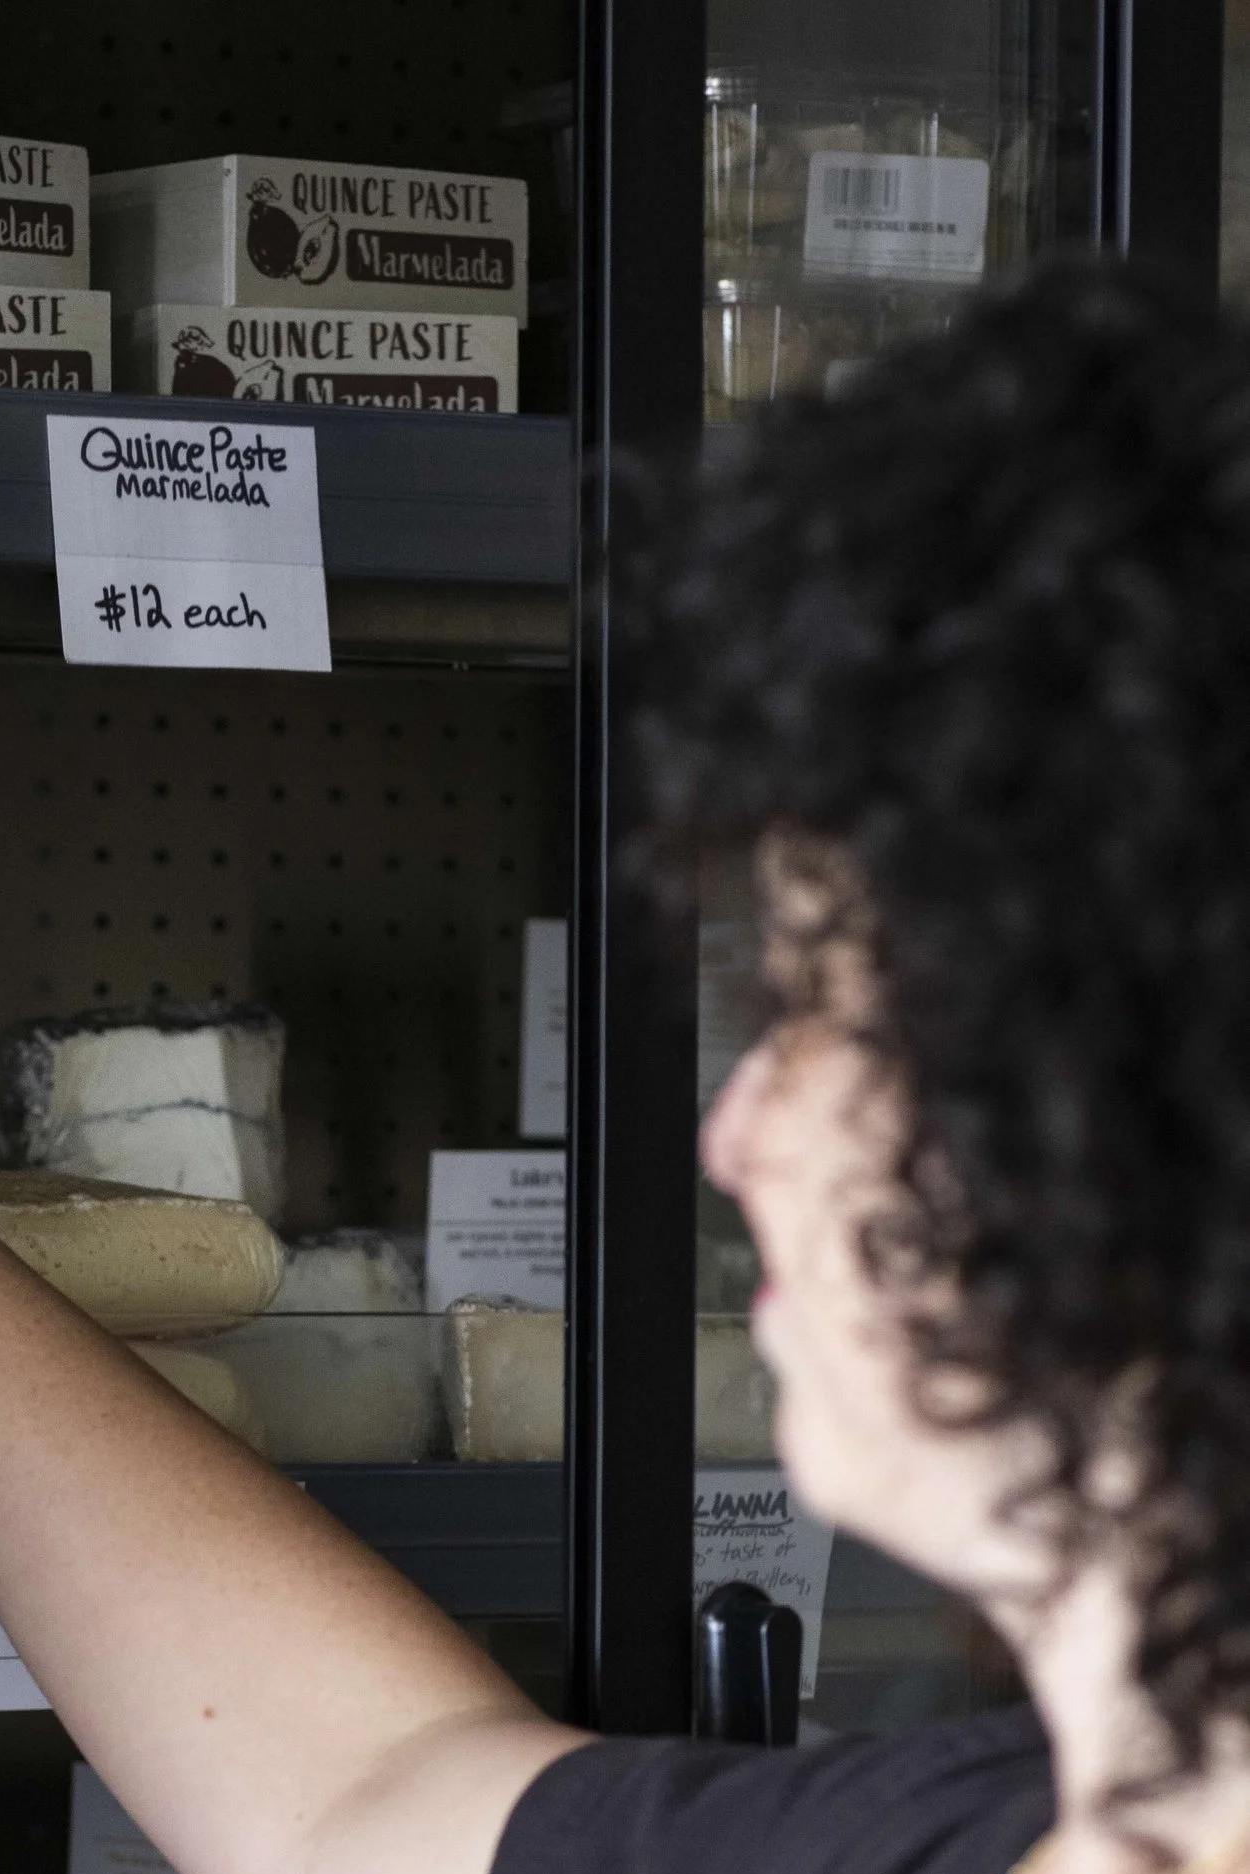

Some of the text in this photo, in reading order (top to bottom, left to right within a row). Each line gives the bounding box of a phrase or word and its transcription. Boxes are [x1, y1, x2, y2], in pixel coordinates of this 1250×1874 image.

[293, 172, 494, 225] QUINCE PASTE
[357, 233, 507, 286] Marmelada
[227, 319, 474, 363] QUINCE PASTE
[80, 427, 288, 475] Quince Paste
[94, 585, 267, 633] $12 each
